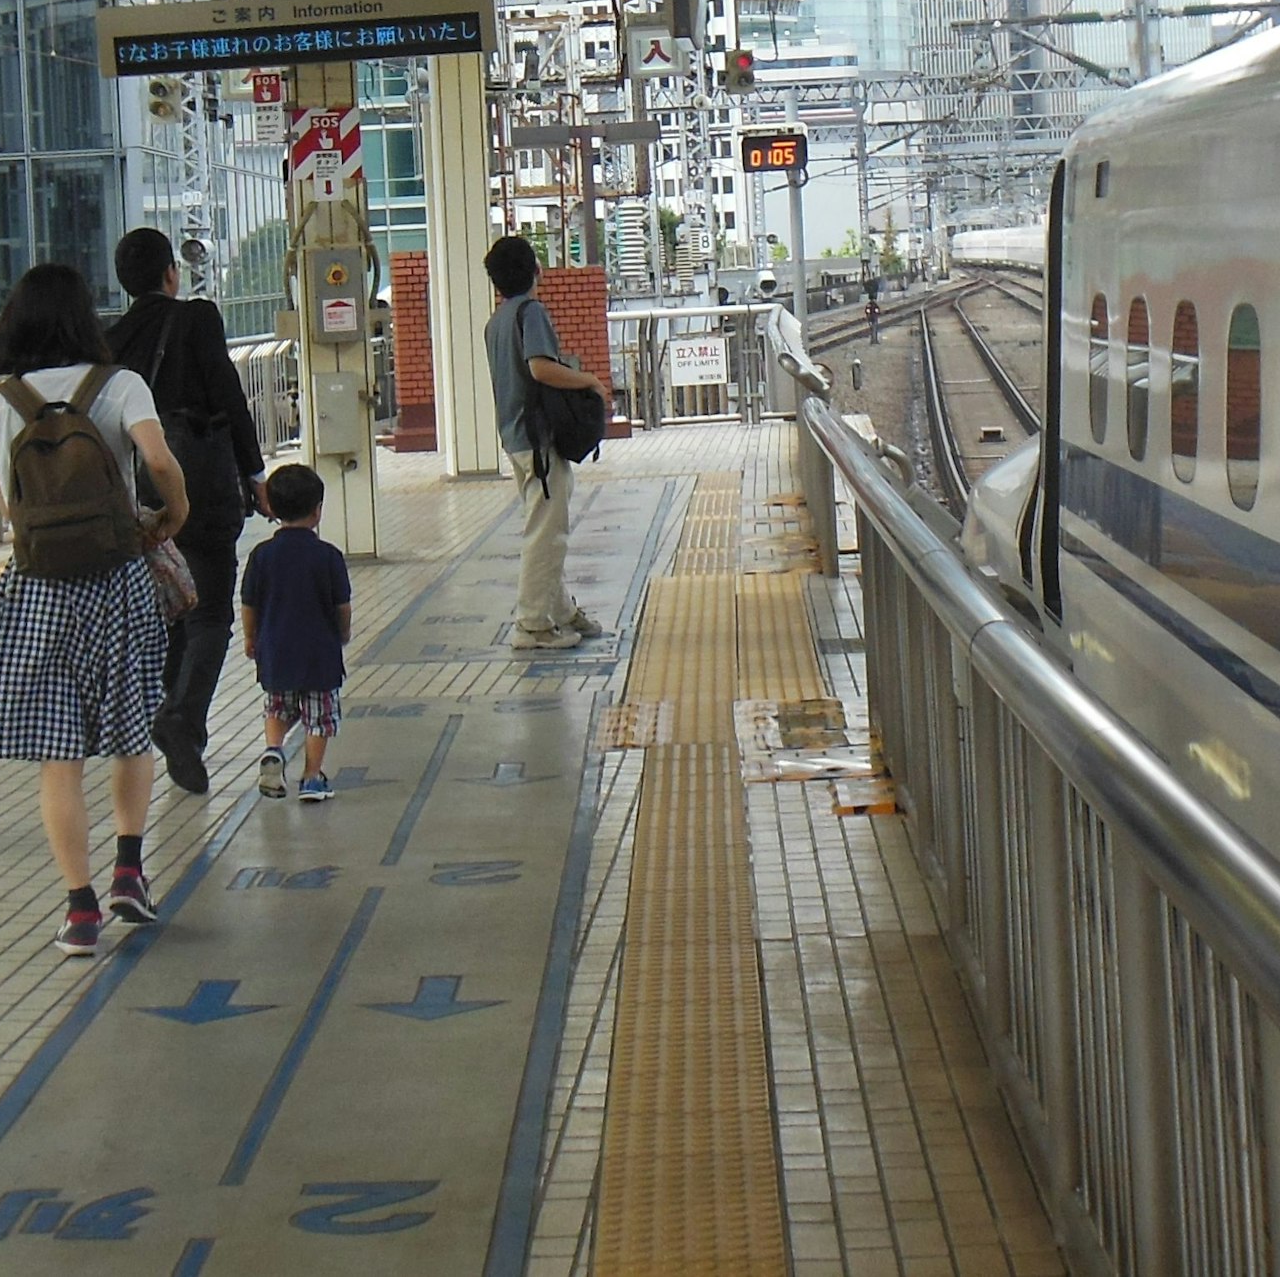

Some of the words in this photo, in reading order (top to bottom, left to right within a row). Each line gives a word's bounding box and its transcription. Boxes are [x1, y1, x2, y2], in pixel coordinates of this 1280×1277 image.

[211, 6, 276, 24] ご案内
[292, 0, 384, 19] Information
[642, 39, 672, 64] 入
[255, 75, 278, 86] SOS
[311, 116, 340, 129] SOS
[701, 235, 710, 249] 8
[676, 345, 721, 359] 立入禁止
[677, 360, 692, 368] OFF
[694, 358, 720, 367] LIMITS
[289, 1178, 442, 1235] 2
